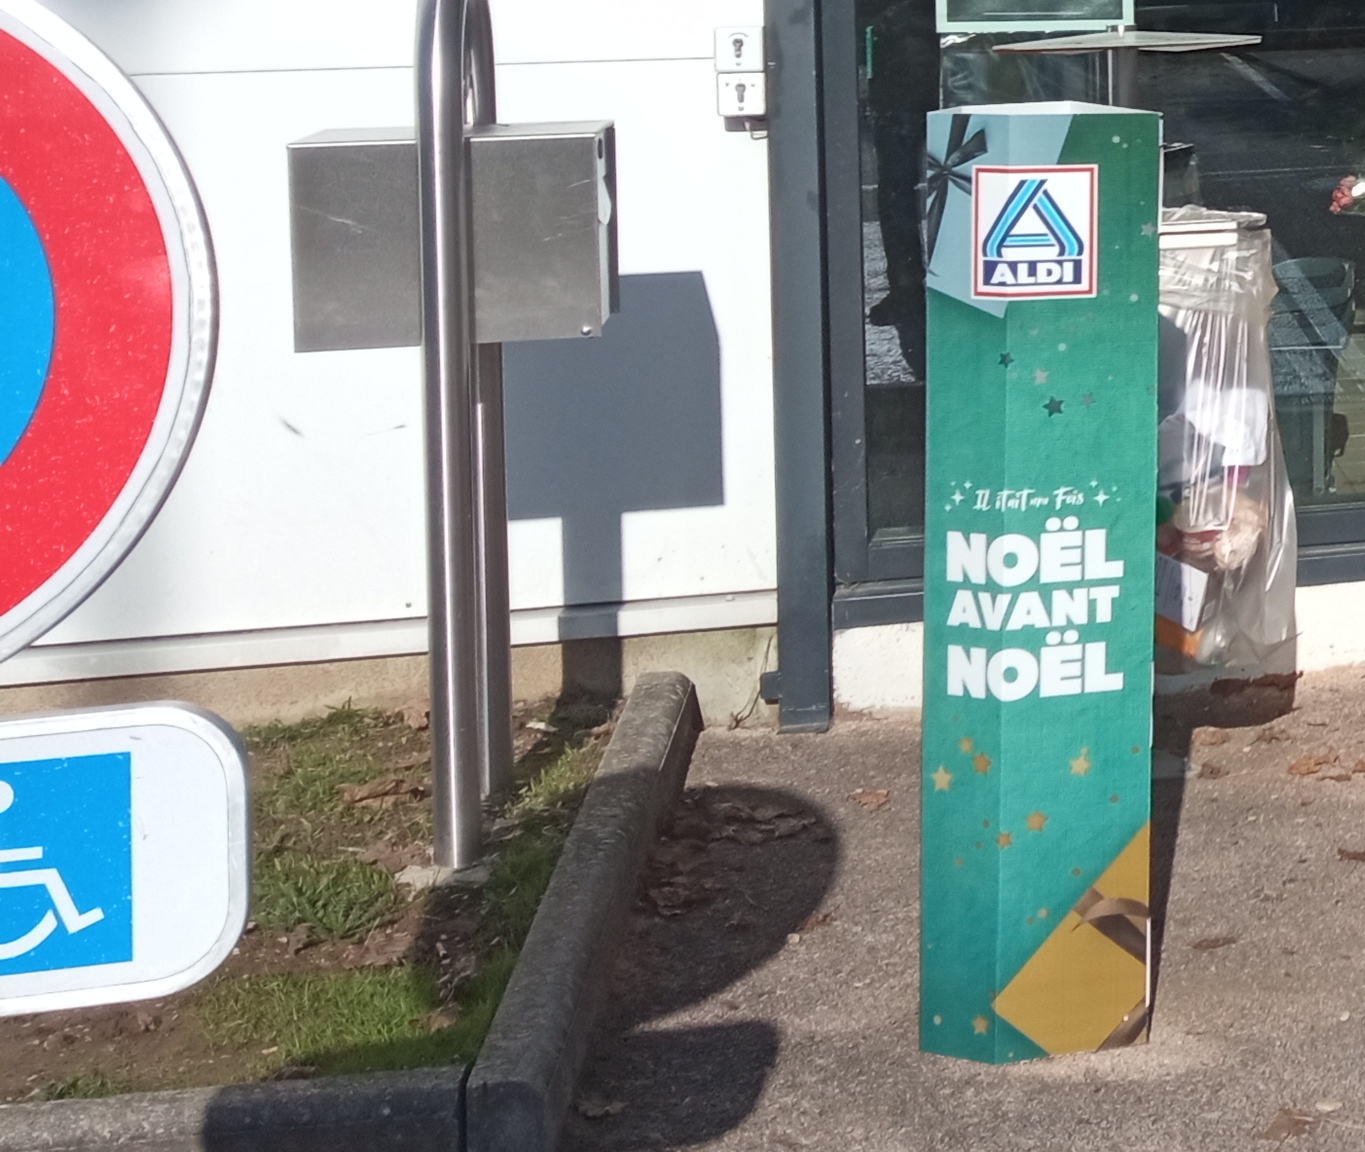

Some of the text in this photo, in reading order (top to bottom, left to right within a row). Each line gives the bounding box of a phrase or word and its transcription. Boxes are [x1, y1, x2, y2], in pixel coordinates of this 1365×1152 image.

[990, 261, 1074, 285] ALDI
[973, 489, 991, 511] Il
[946, 515, 1124, 587] NOËL
[946, 585, 1120, 631] AVANT
[947, 629, 1124, 702] NOËL
